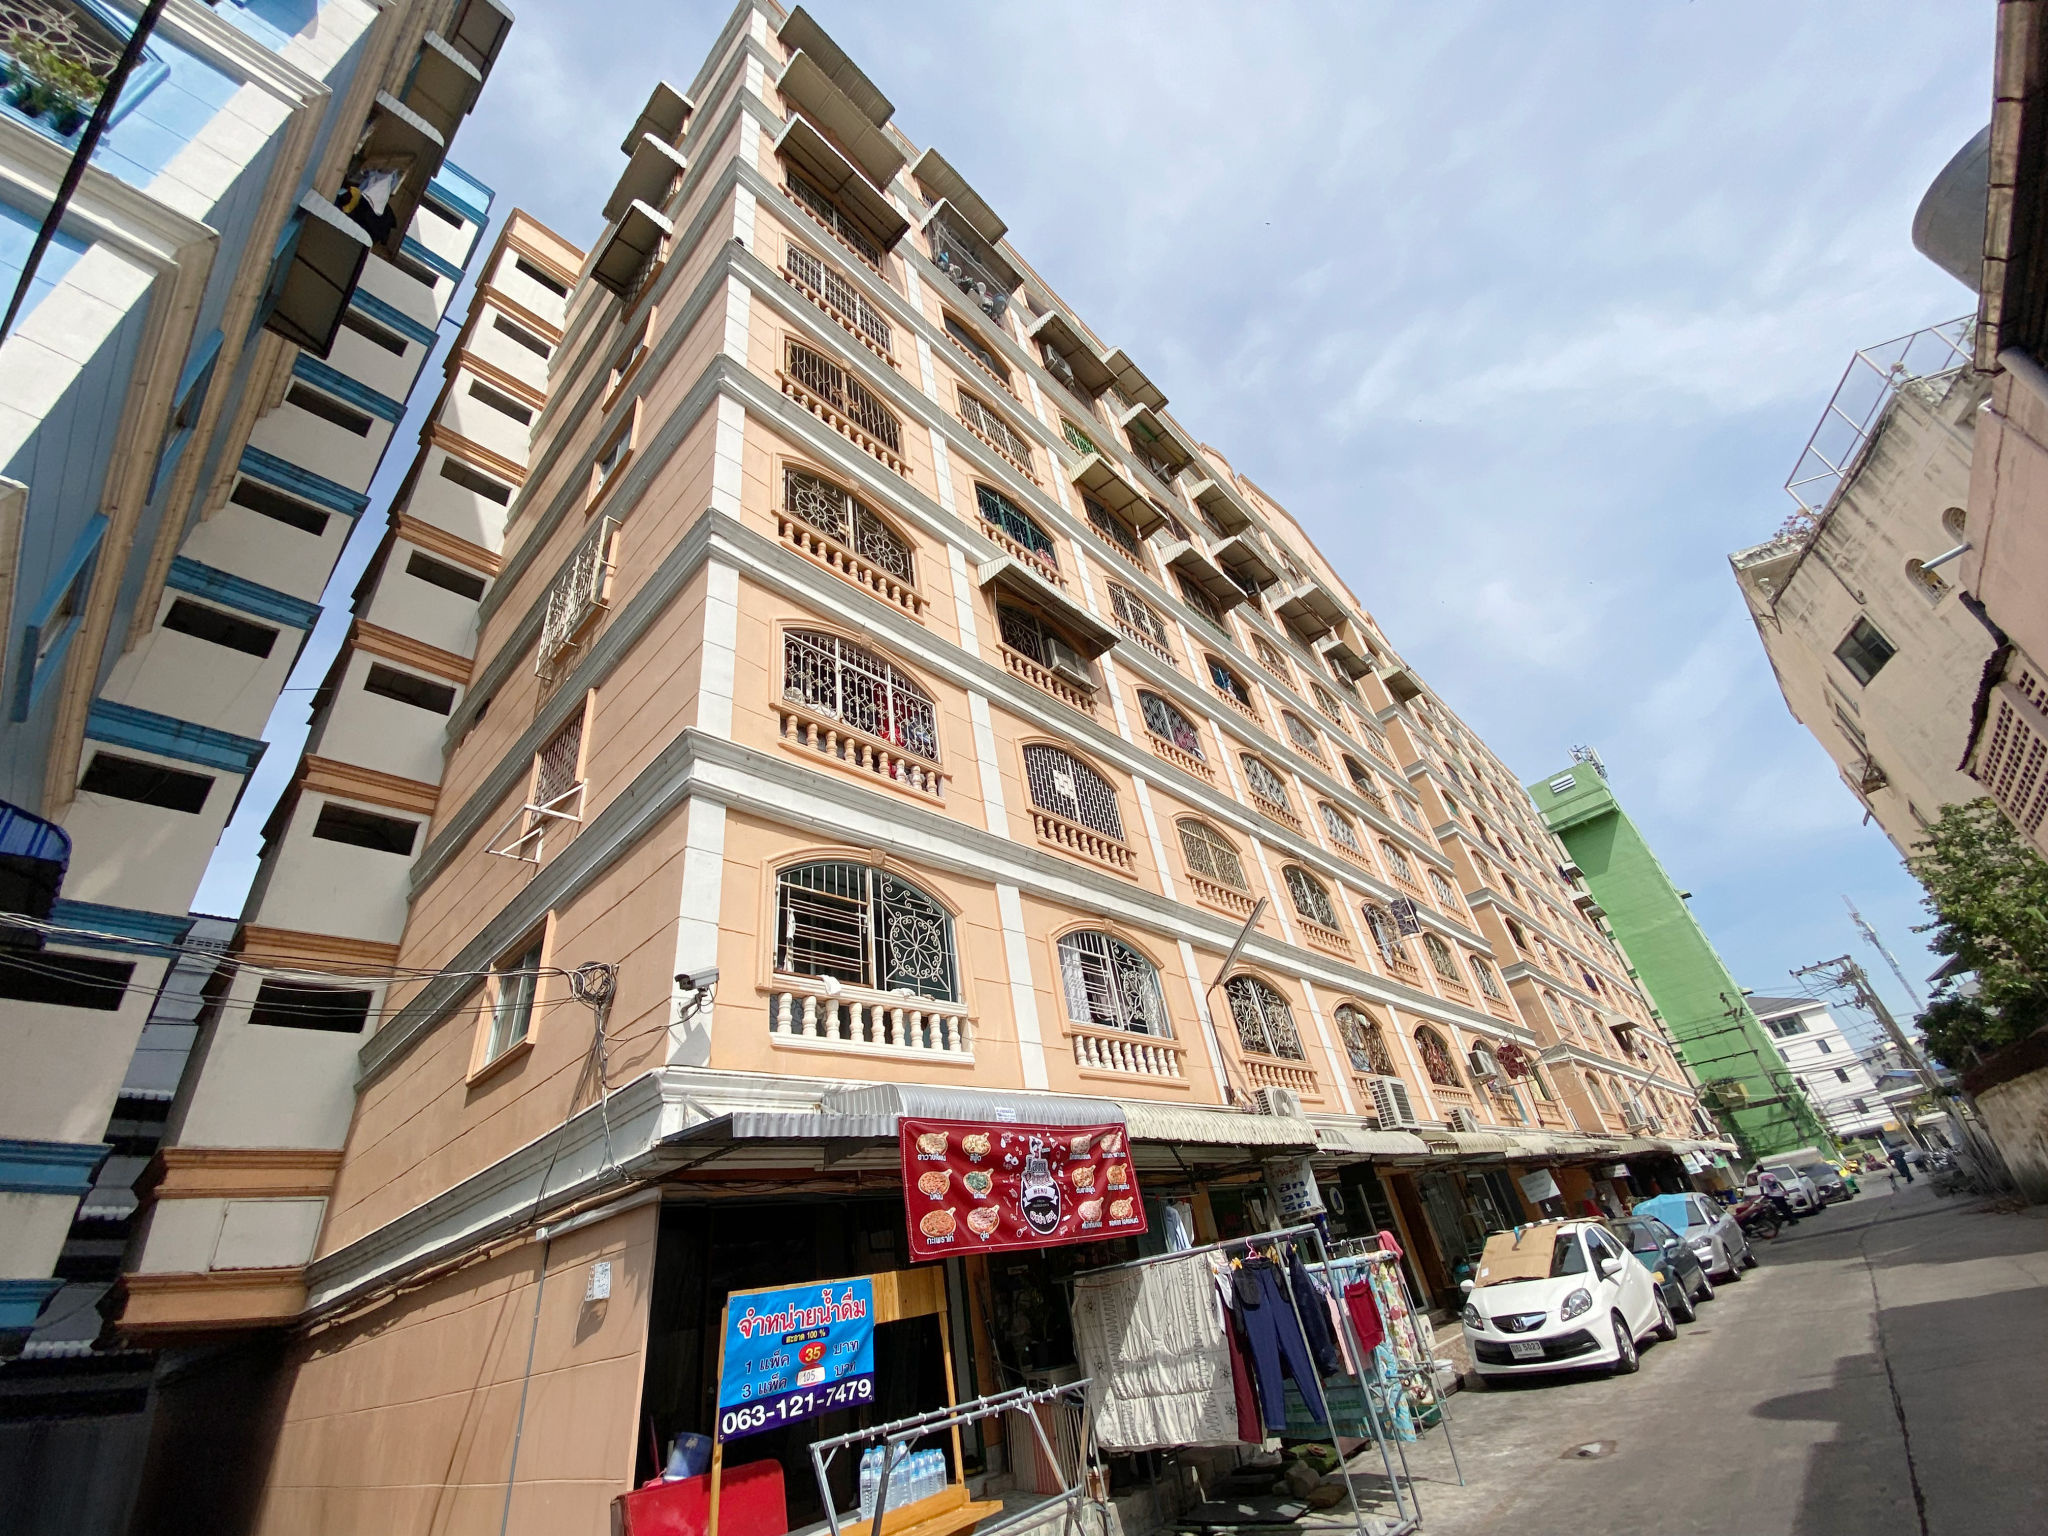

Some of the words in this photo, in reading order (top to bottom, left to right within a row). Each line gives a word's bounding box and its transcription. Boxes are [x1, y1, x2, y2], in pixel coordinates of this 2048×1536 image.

[737, 1287, 866, 1338] จำหน่ายน้ำดื่ม
[786, 1333, 805, 1343] สะอาด
[807, 1330, 818, 1339] 100
[744, 1361, 752, 1373] 1
[759, 1350, 790, 1371] แพ็ค
[804, 1346, 822, 1361] 35
[833, 1339, 860, 1355] บาท
[742, 1384, 752, 1399] 3
[758, 1374, 787, 1395] แพ็ค
[834, 1361, 857, 1377] บาท
[722, 1378, 871, 1434] 063-121-7479
